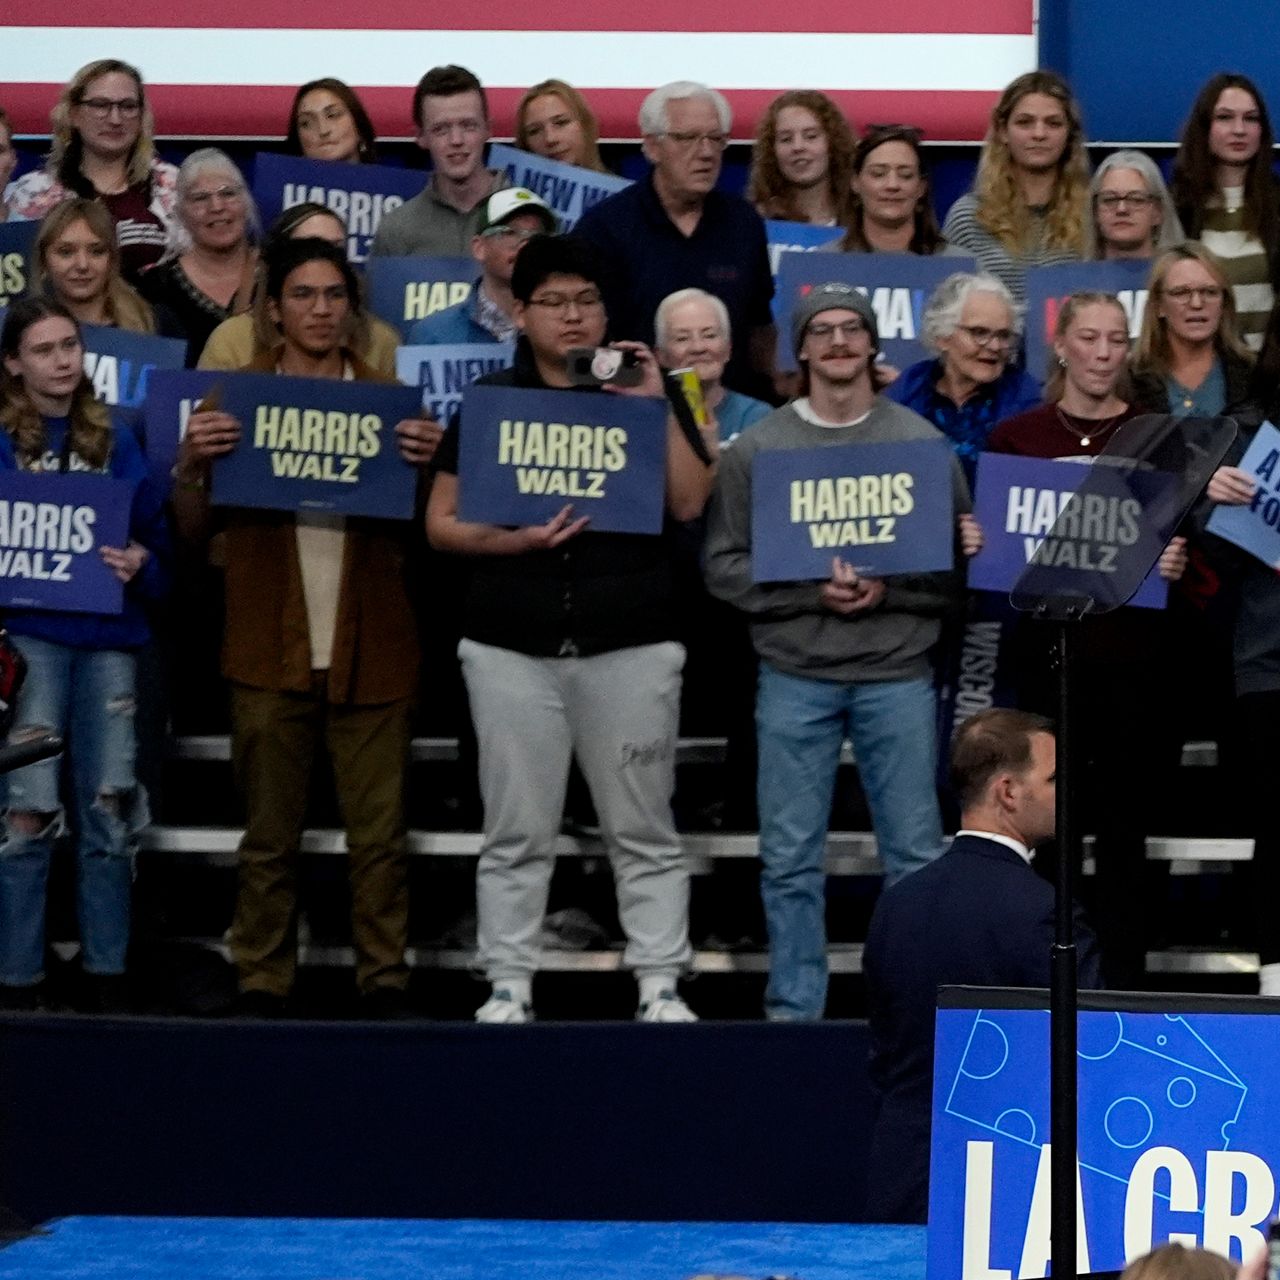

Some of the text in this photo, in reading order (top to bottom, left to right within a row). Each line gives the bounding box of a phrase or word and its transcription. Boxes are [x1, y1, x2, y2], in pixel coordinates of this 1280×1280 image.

[254, 404, 382, 458] HARRIS
[498, 420, 628, 472] HARRIS
[271, 451, 360, 483] WALZ
[516, 467, 607, 498] WALZ
[1256, 448, 1280, 483] A
[790, 473, 914, 523] HARRIS
[1006, 486, 1142, 546] HARRIS
[809, 517, 896, 548] WALZ
[1024, 536, 1119, 573] WALZ
